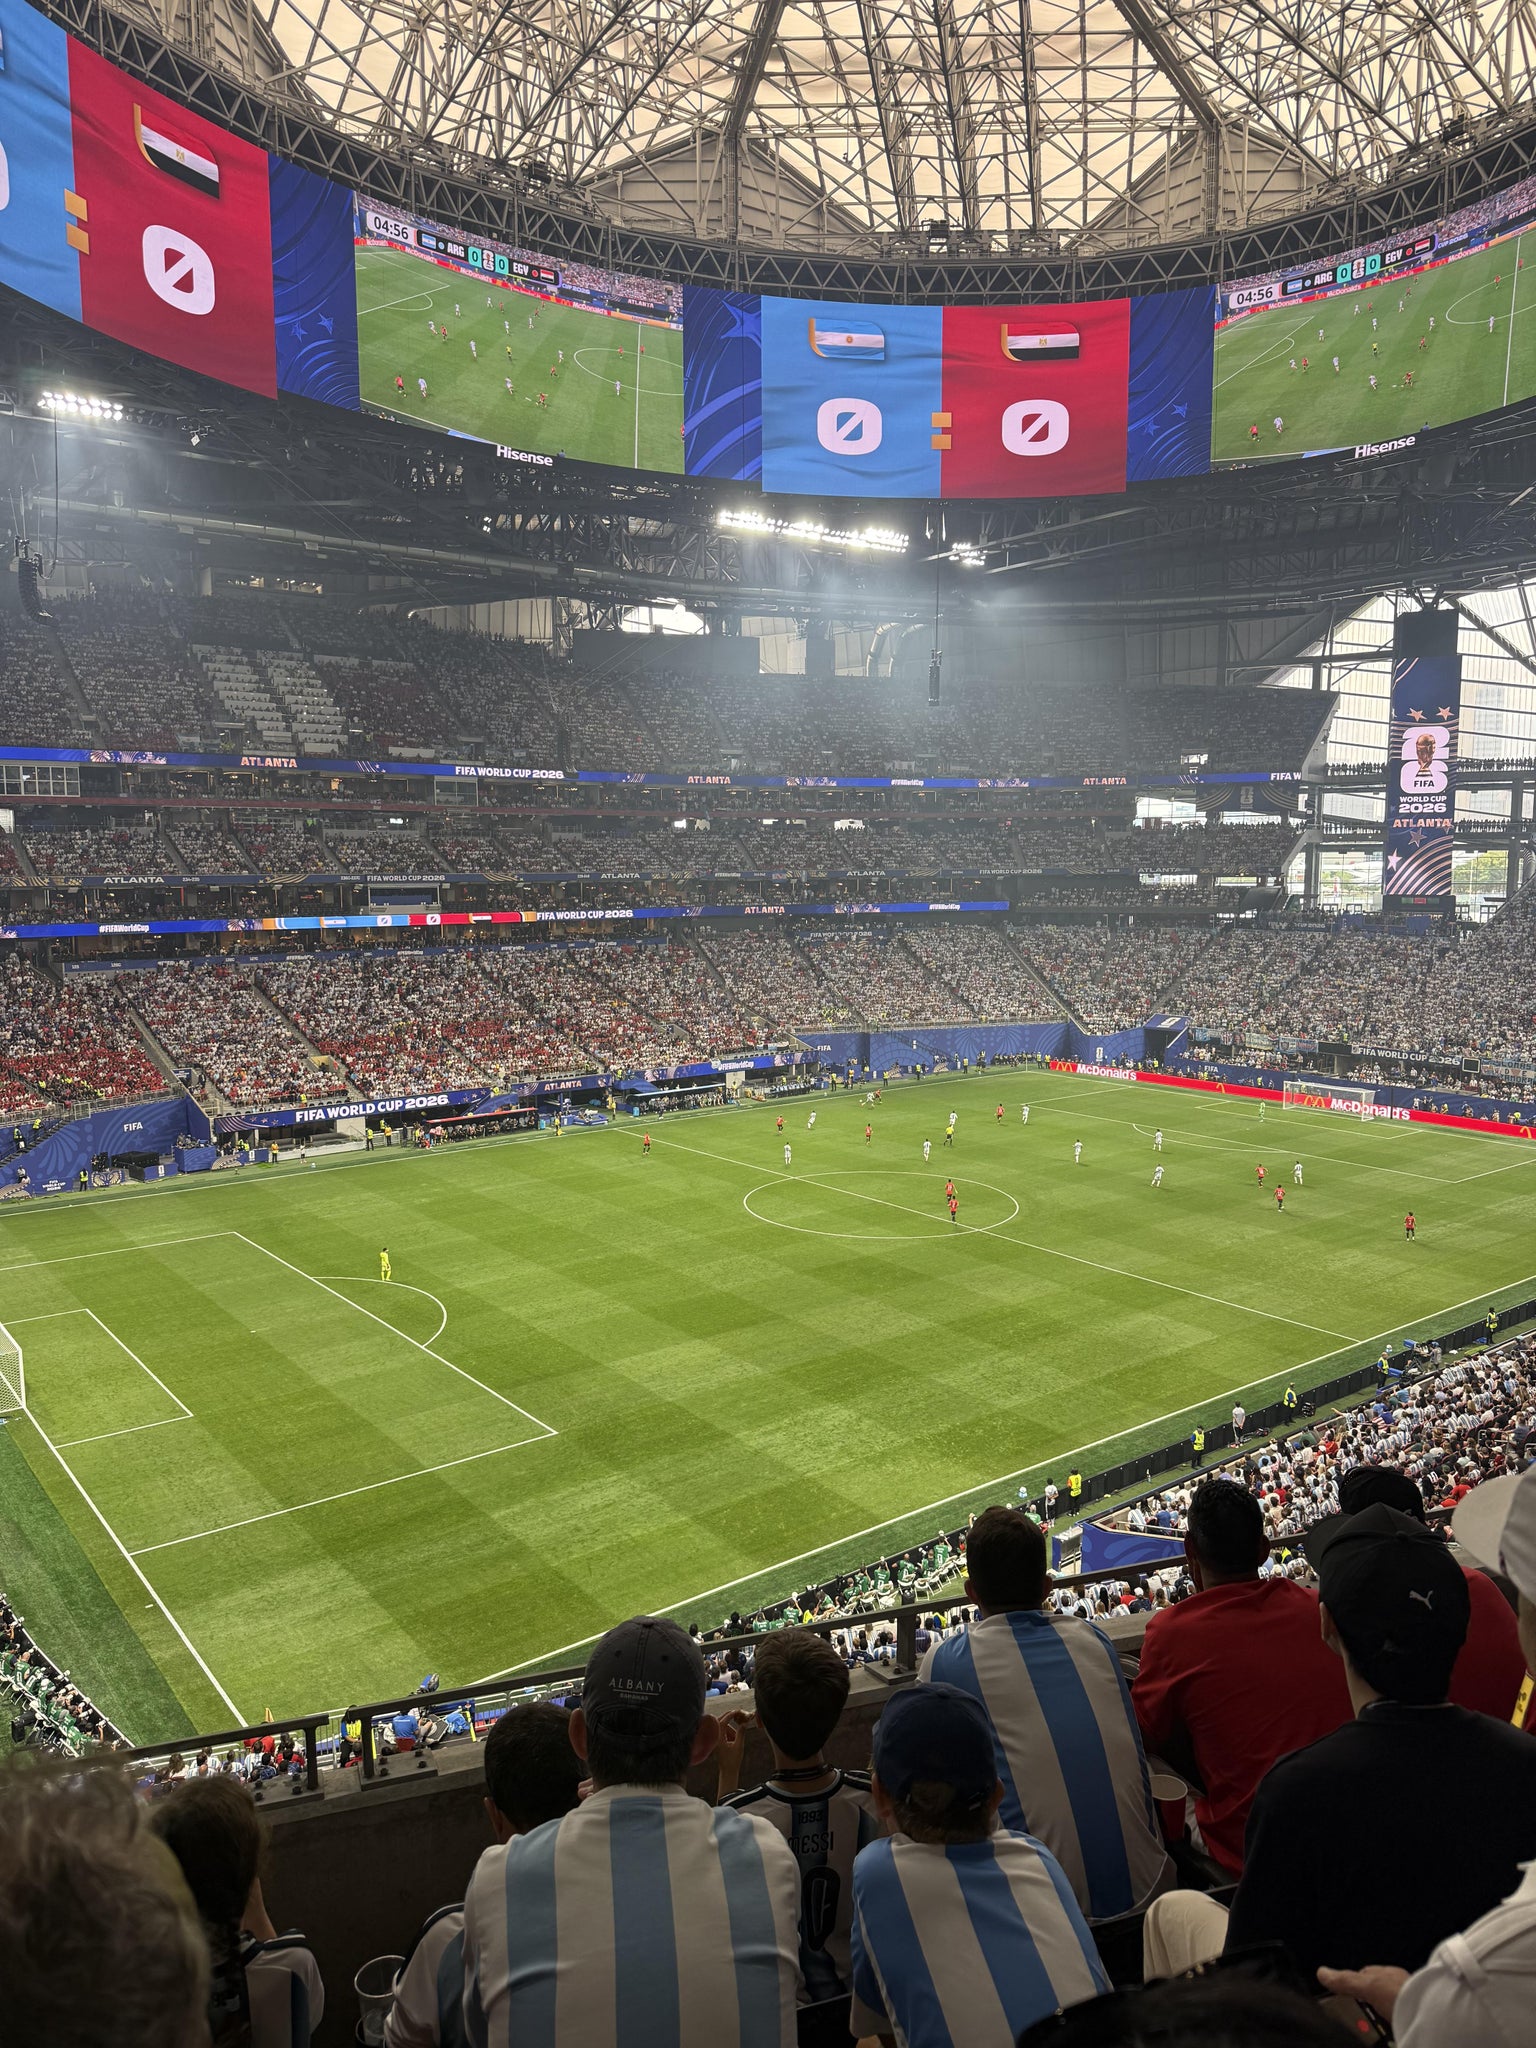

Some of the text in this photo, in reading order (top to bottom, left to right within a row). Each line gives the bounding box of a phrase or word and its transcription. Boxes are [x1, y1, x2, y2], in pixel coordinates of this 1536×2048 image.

[374, 216, 409, 240] 04:56
[447, 242, 479, 263] ARG 0
[1370, 248, 1403, 270] 0 EGY
[142, 224, 216, 316] 0
[498, 258, 529, 276] 0 EGY
[1314, 268, 1348, 286] ARG 0
[1236, 286, 1273, 304] 04:56
[628, 298, 654, 309] ATLANTA
[817, 398, 882, 455] 0
[1002, 399, 1070, 456] 0
[1354, 436, 1416, 458] Hisense
[496, 444, 554, 466] Hisense
[240, 756, 298, 768] ATLANTA
[455, 766, 564, 780] FIFA WORLD CUP 2026
[688, 776, 731, 784] ATLANTA
[1270, 772, 1292, 780] FIFA
[1082, 778, 1126, 786] ATLANTA
[1414, 780, 1434, 788] FIFA
[1398, 803, 1447, 813] 2026
[1392, 818, 1452, 828] ATLANTA
[104, 876, 164, 884] ATLANTA
[536, 910, 633, 921] FIFA WORLD CUP 2026
[744, 906, 785, 914] ATLANTA
[99, 924, 150, 933] #FIFAWorldCup
[1358, 1048, 1376, 1057] FIFA
[1377, 1049, 1408, 1060] WORLD
[1410, 1052, 1428, 1062] CUP
[1076, 1063, 1137, 1081] McDonald's
[1204, 1065, 1218, 1073] FIFA
[544, 1080, 582, 1091] ATLANTA
[296, 1094, 449, 1123] FIFA WORLD CUP 2026
[1330, 1098, 1410, 1120] McDonald's
[124, 1122, 144, 1132] FIFA
[608, 1677, 664, 1692] ALBANY
[798, 1809, 823, 1825] 1893
[788, 1831, 834, 1855] MESSI
